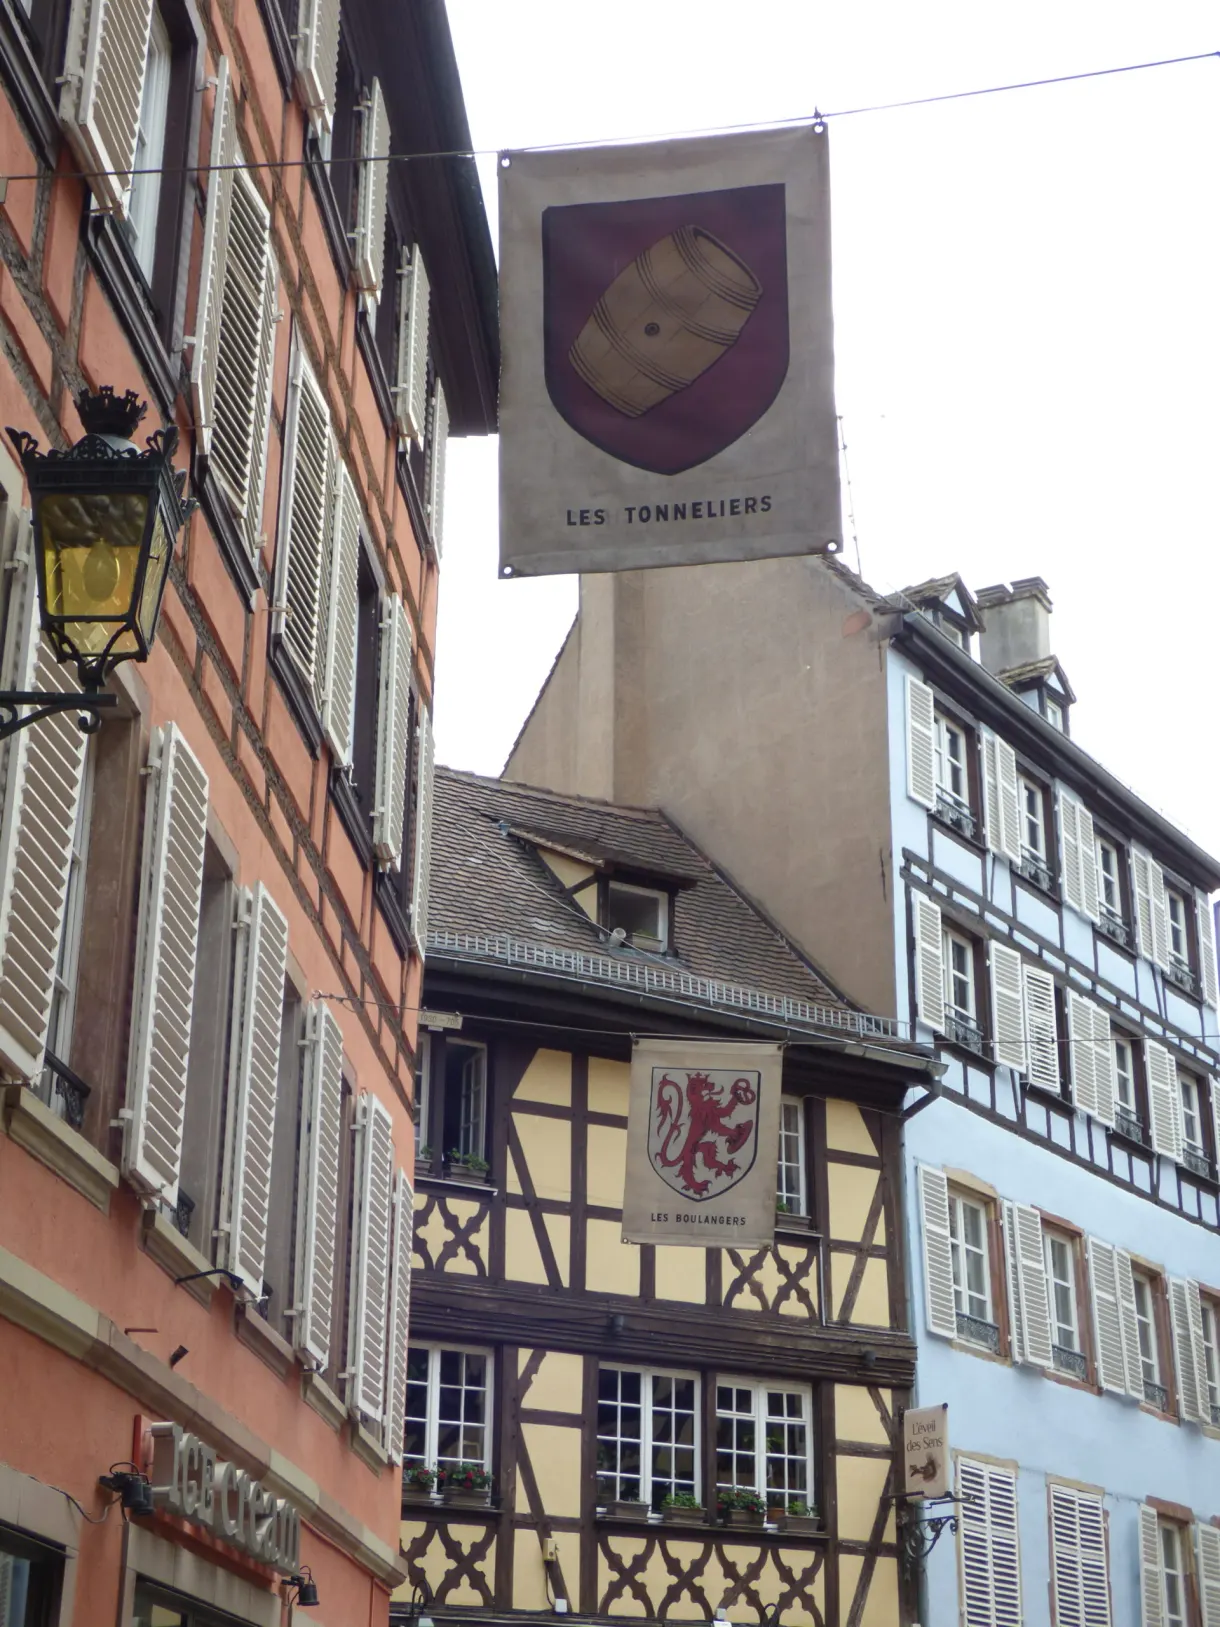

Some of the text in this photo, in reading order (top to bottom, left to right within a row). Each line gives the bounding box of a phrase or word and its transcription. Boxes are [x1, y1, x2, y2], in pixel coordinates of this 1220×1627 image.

[566, 495, 773, 527] LES TONNELIERS
[651, 1213, 747, 1226] LES BOULANGERS
[912, 1420, 937, 1436] L'éveil
[906, 1436, 944, 1453] des Sens
